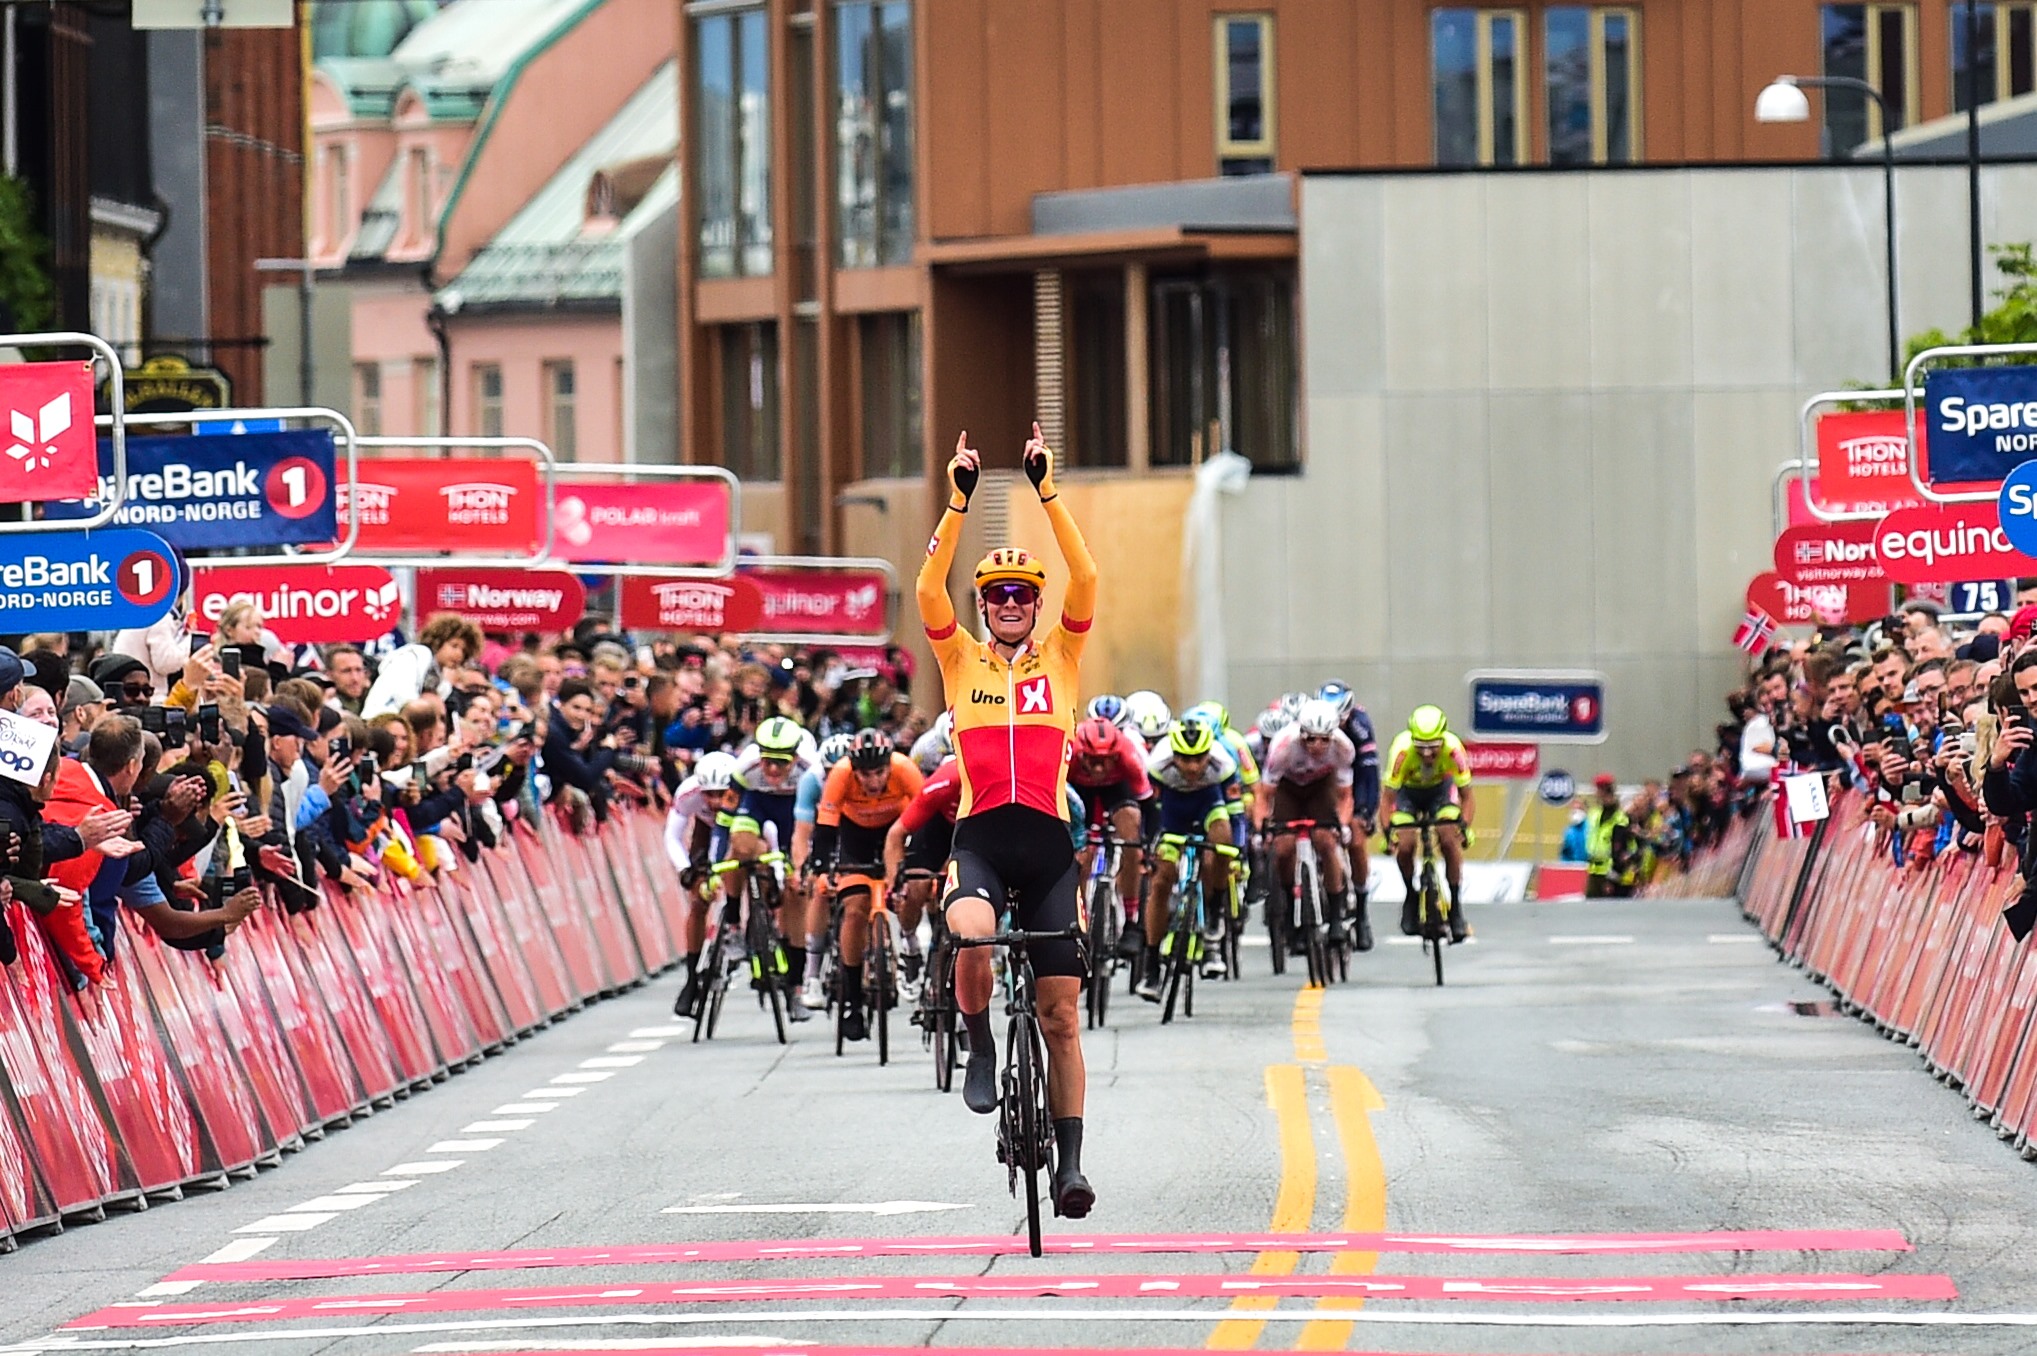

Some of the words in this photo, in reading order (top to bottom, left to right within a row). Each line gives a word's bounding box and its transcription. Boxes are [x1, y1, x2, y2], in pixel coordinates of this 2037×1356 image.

[1840, 437, 1907, 462] THON
[1848, 461, 1907, 477] HOTELS
[282, 467, 306, 507] 1
[445, 484, 512, 509] THON
[113, 499, 261, 525] NORD-NORGE
[448, 508, 509, 524] HOTELS
[0, 554, 111, 588] eBank
[132, 559, 153, 596] 1
[467, 584, 562, 612] Norway
[655, 585, 729, 609] THON
[1962, 582, 1999, 611] 75
[971, 689, 1006, 704] Uno
[1021, 678, 1048, 713] X
